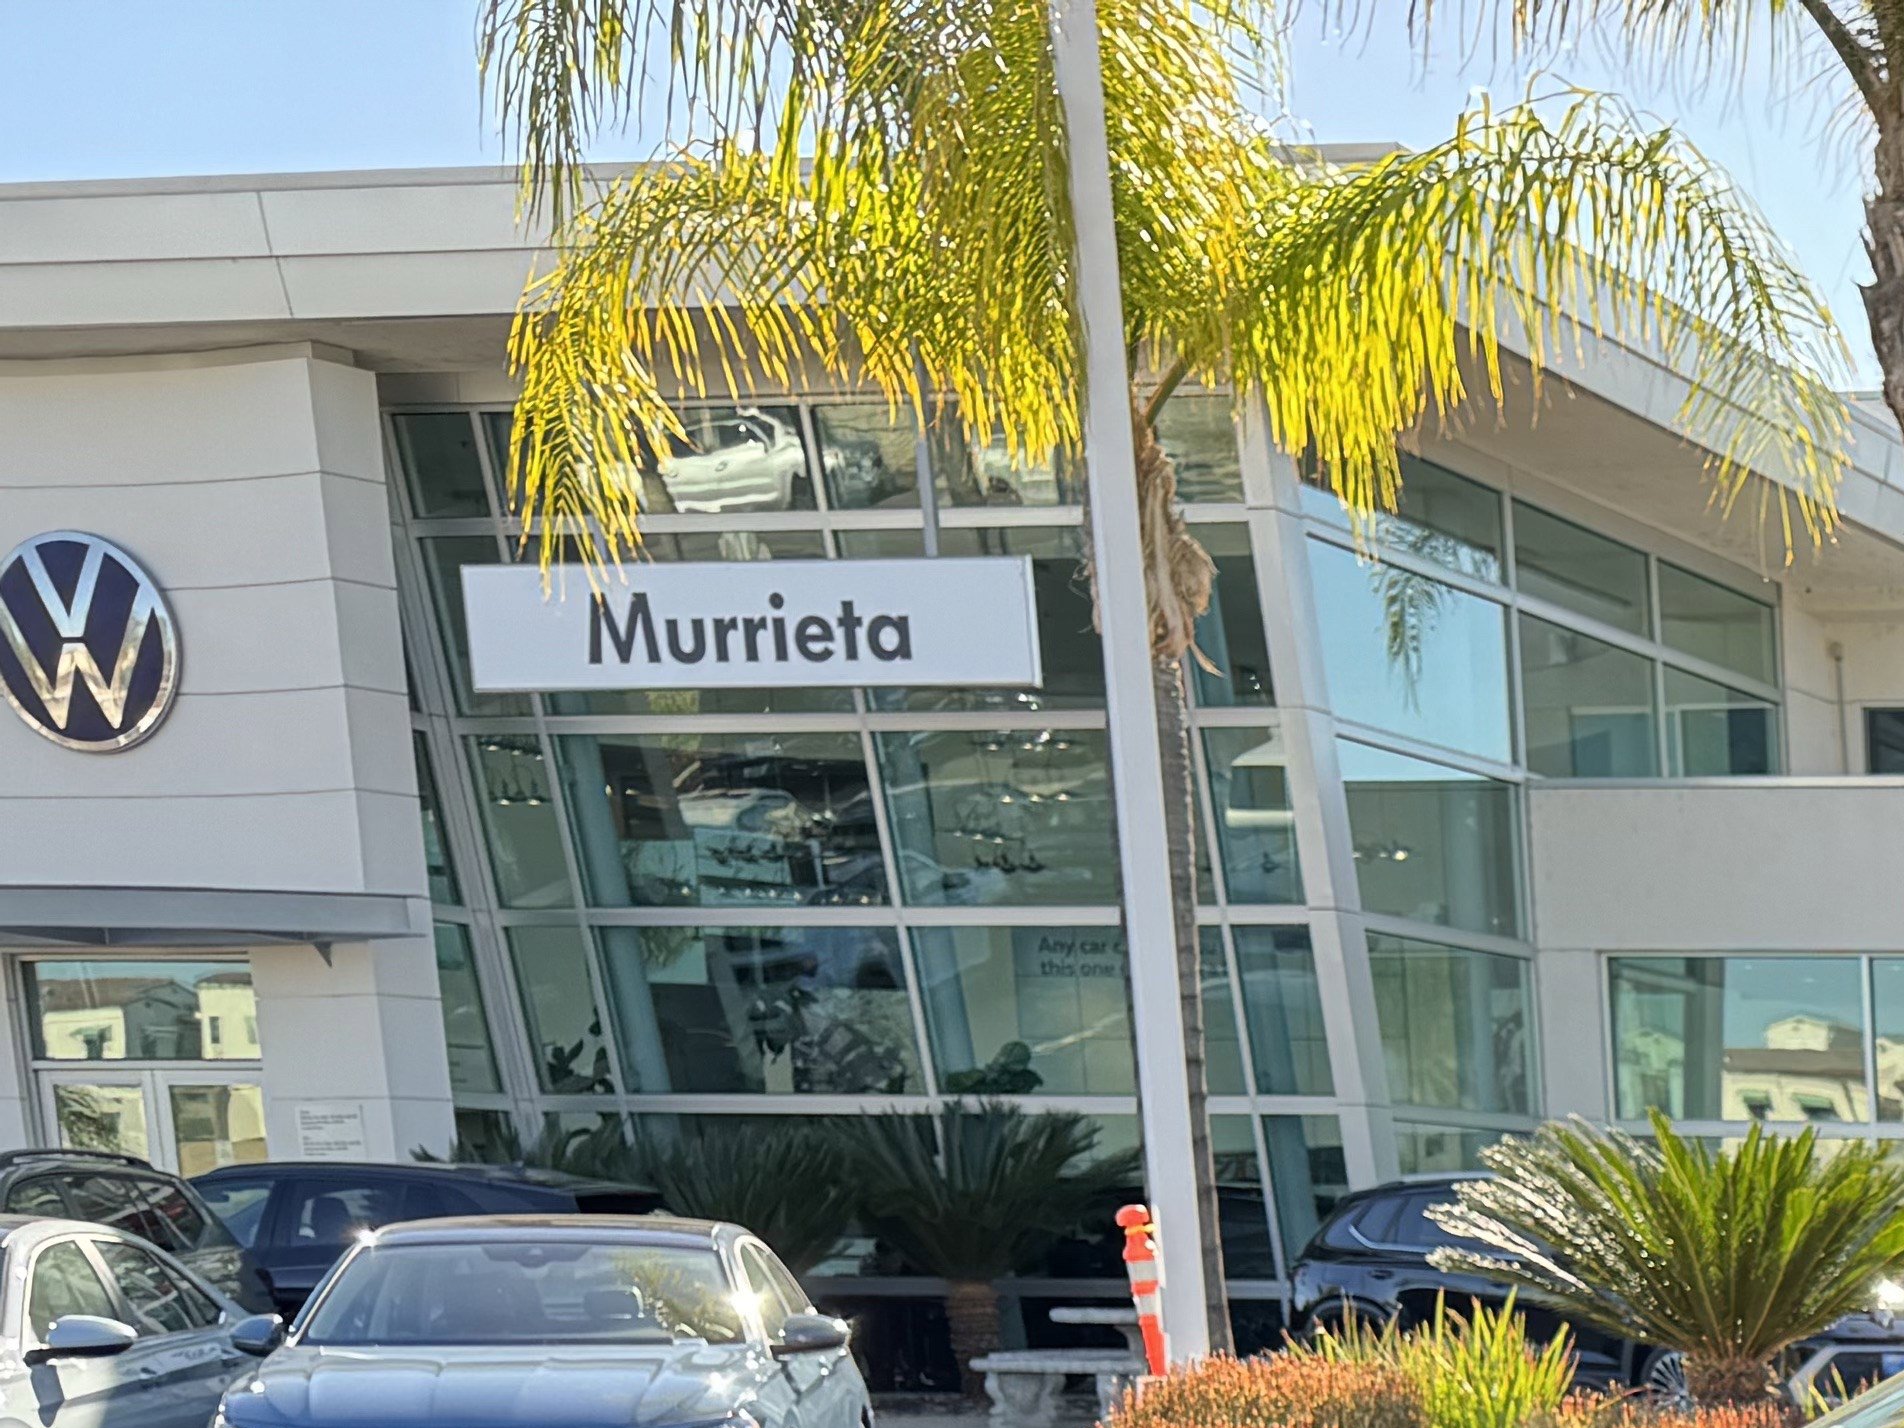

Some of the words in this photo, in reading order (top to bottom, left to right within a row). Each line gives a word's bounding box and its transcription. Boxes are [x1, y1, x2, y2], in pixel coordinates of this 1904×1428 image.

[0, 530, 180, 752] VW
[588, 592, 912, 664] Murrieta
[1039, 937, 1076, 957] Any
[1040, 960, 1075, 976] this
[1080, 962, 1115, 977] one
